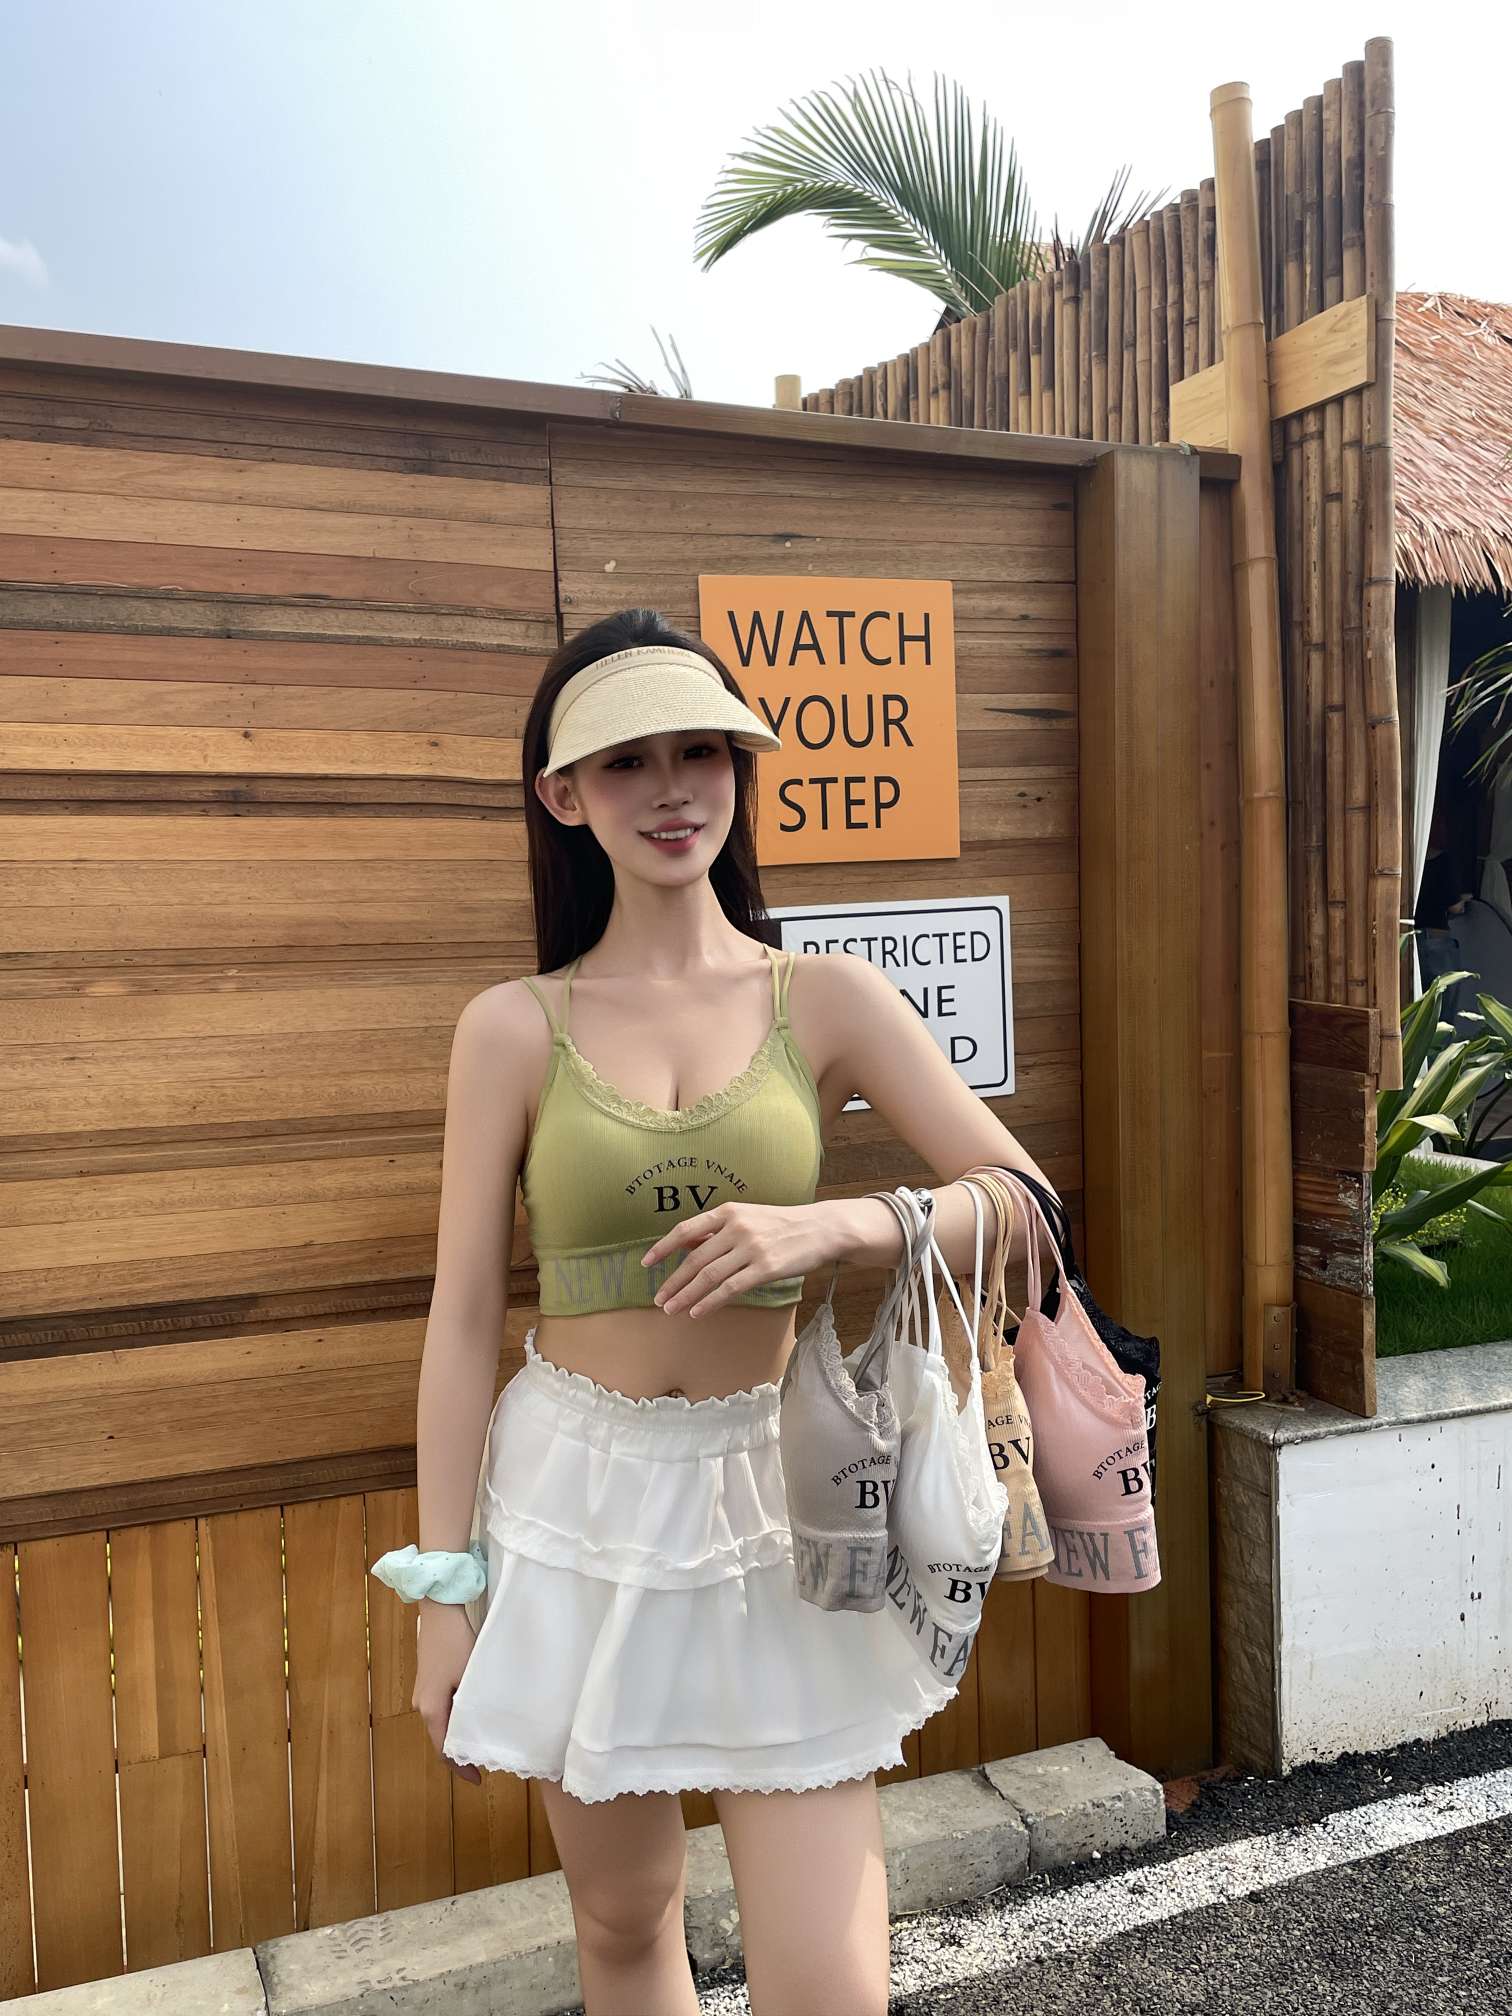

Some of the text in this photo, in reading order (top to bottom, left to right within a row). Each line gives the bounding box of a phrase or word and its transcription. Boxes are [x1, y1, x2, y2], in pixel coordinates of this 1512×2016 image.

[728, 610, 933, 667] WATCH
[758, 694, 914, 750] YOUR
[779, 776, 901, 832] STEP
[899, 985, 957, 1019] NE
[625, 1156, 748, 1196] BTOTAGE VNAIE
[653, 1184, 719, 1213] BV
[555, 1250, 627, 1304] NEW
[831, 1455, 892, 1487] BTOTAGE
[1092, 1440, 1145, 1481] BTOTAGE
